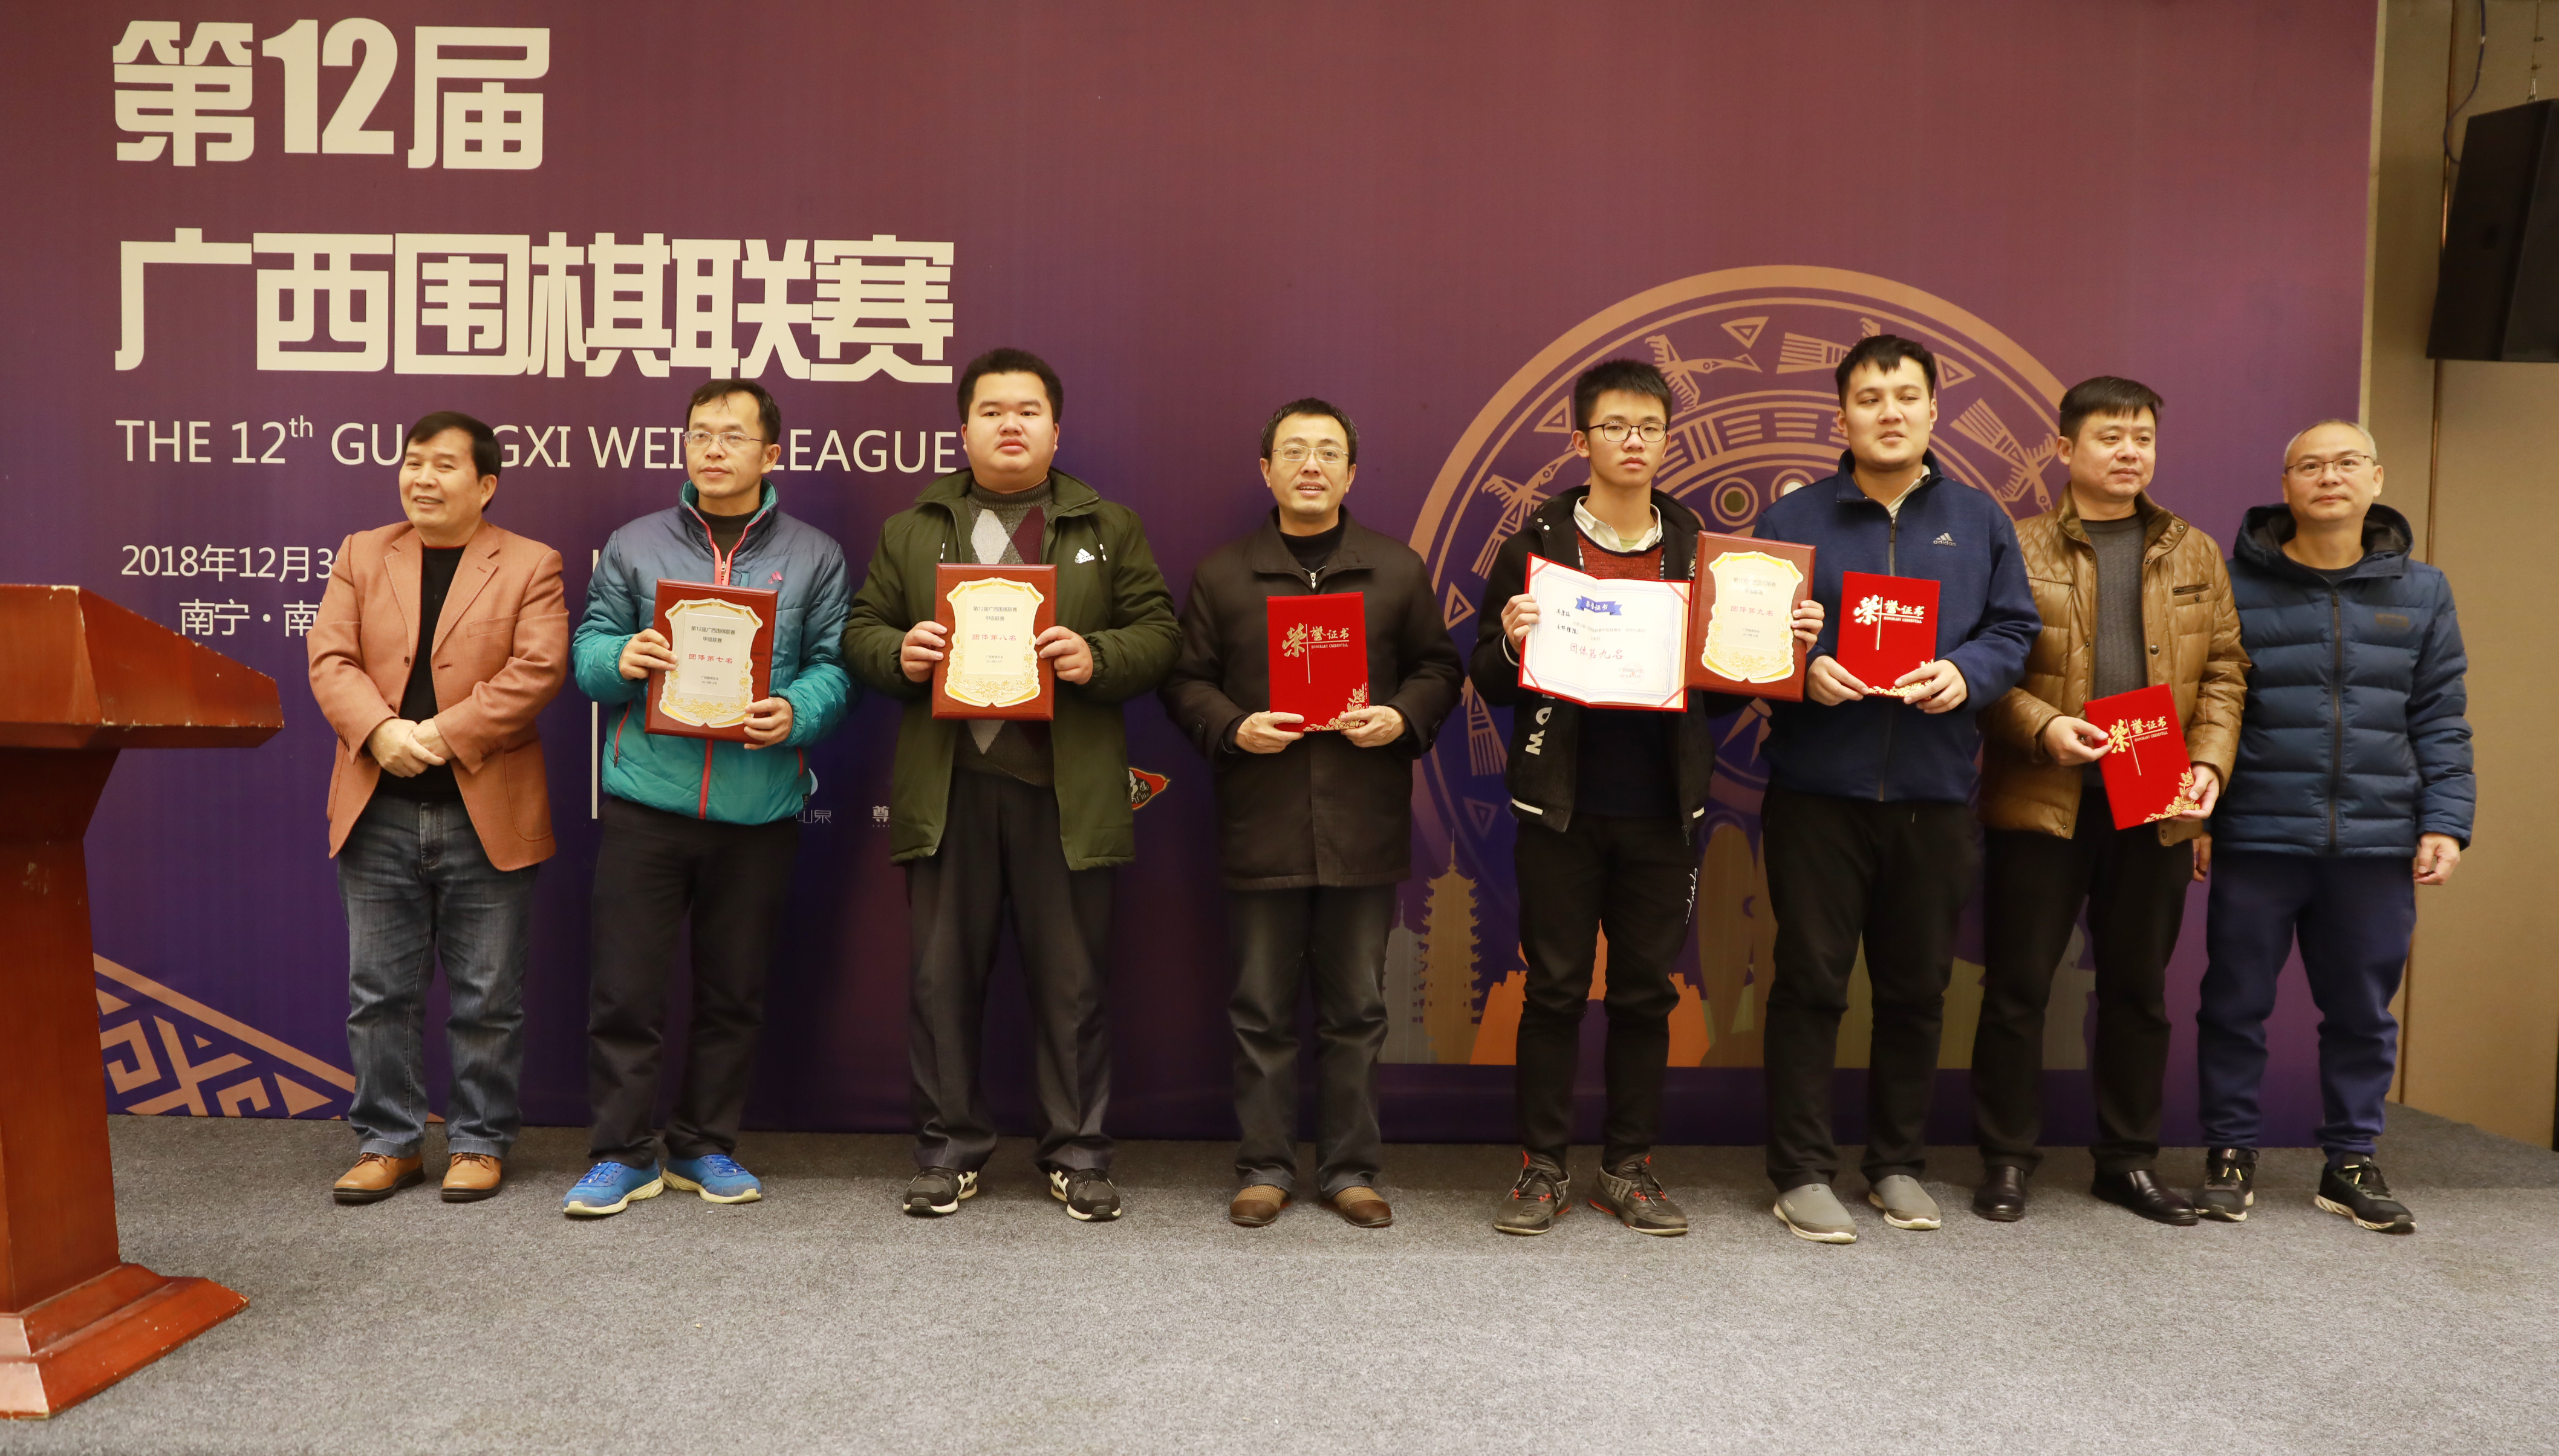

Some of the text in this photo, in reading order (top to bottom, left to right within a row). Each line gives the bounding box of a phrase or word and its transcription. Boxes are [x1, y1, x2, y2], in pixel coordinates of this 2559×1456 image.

[112, 18, 550, 170] 第12届
[115, 228, 954, 383] 广西围棋联赛
[116, 420, 211, 463] THE
[232, 415, 313, 464] 12th
[331, 423, 571, 467] GUGXI
[774, 429, 957, 473] EAGUE
[121, 544, 338, 582] 2018年12月3
[1585, 600, 1609, 611] 荣誉证书
[1731, 605, 1774, 616] 团体第九名
[691, 625, 736, 635] 第12届广西围棋联赛
[1281, 622, 1349, 658] 荣誉证书
[689, 653, 733, 664] 团体第七名
[1570, 642, 1624, 661] 团体第九名
